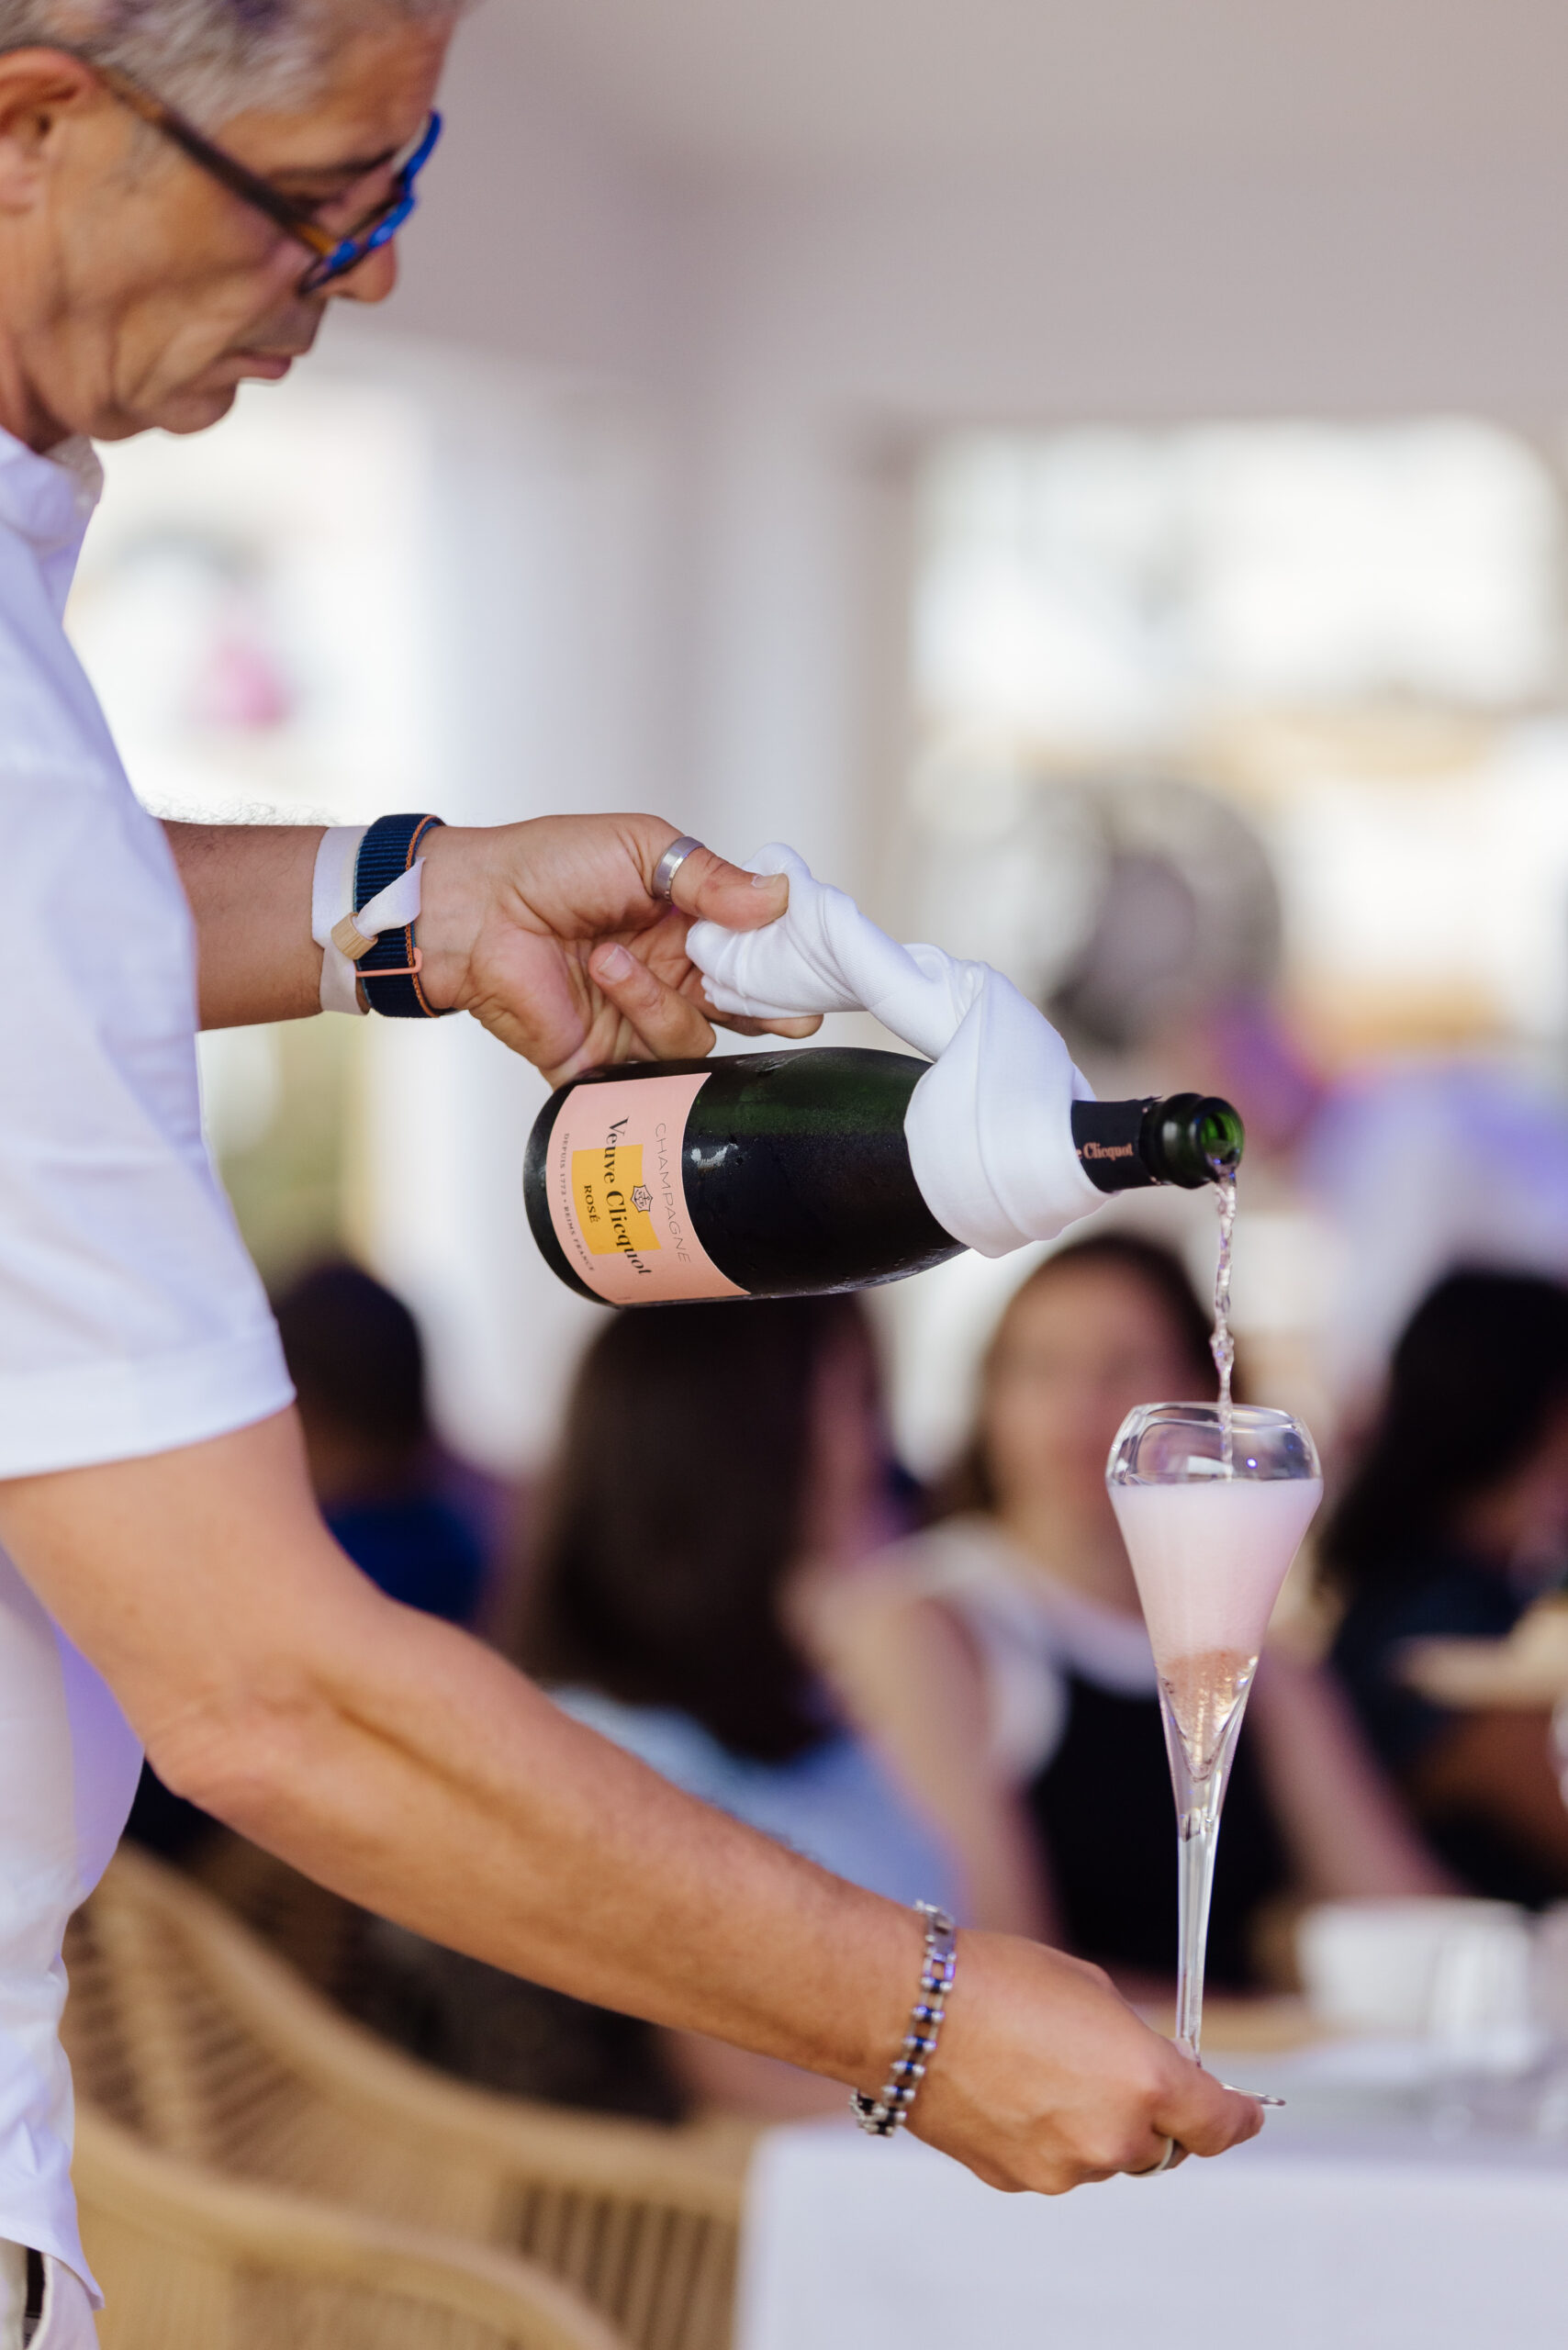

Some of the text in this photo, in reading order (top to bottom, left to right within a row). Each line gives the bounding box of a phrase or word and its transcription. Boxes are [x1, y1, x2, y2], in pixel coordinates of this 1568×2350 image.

[559, 1133, 570, 1169] DEPUIS
[603, 1116, 630, 1184] Veuve
[1083, 1142, 1134, 1161] Clicquot
[584, 1184, 600, 1224] ROSÉ
[655, 1123, 691, 1263] CHAMPAGNE
[564, 1206, 576, 1237] REIMS
[606, 1191, 653, 1275] Clicquot
[573, 1238, 595, 1271] FRANCE
